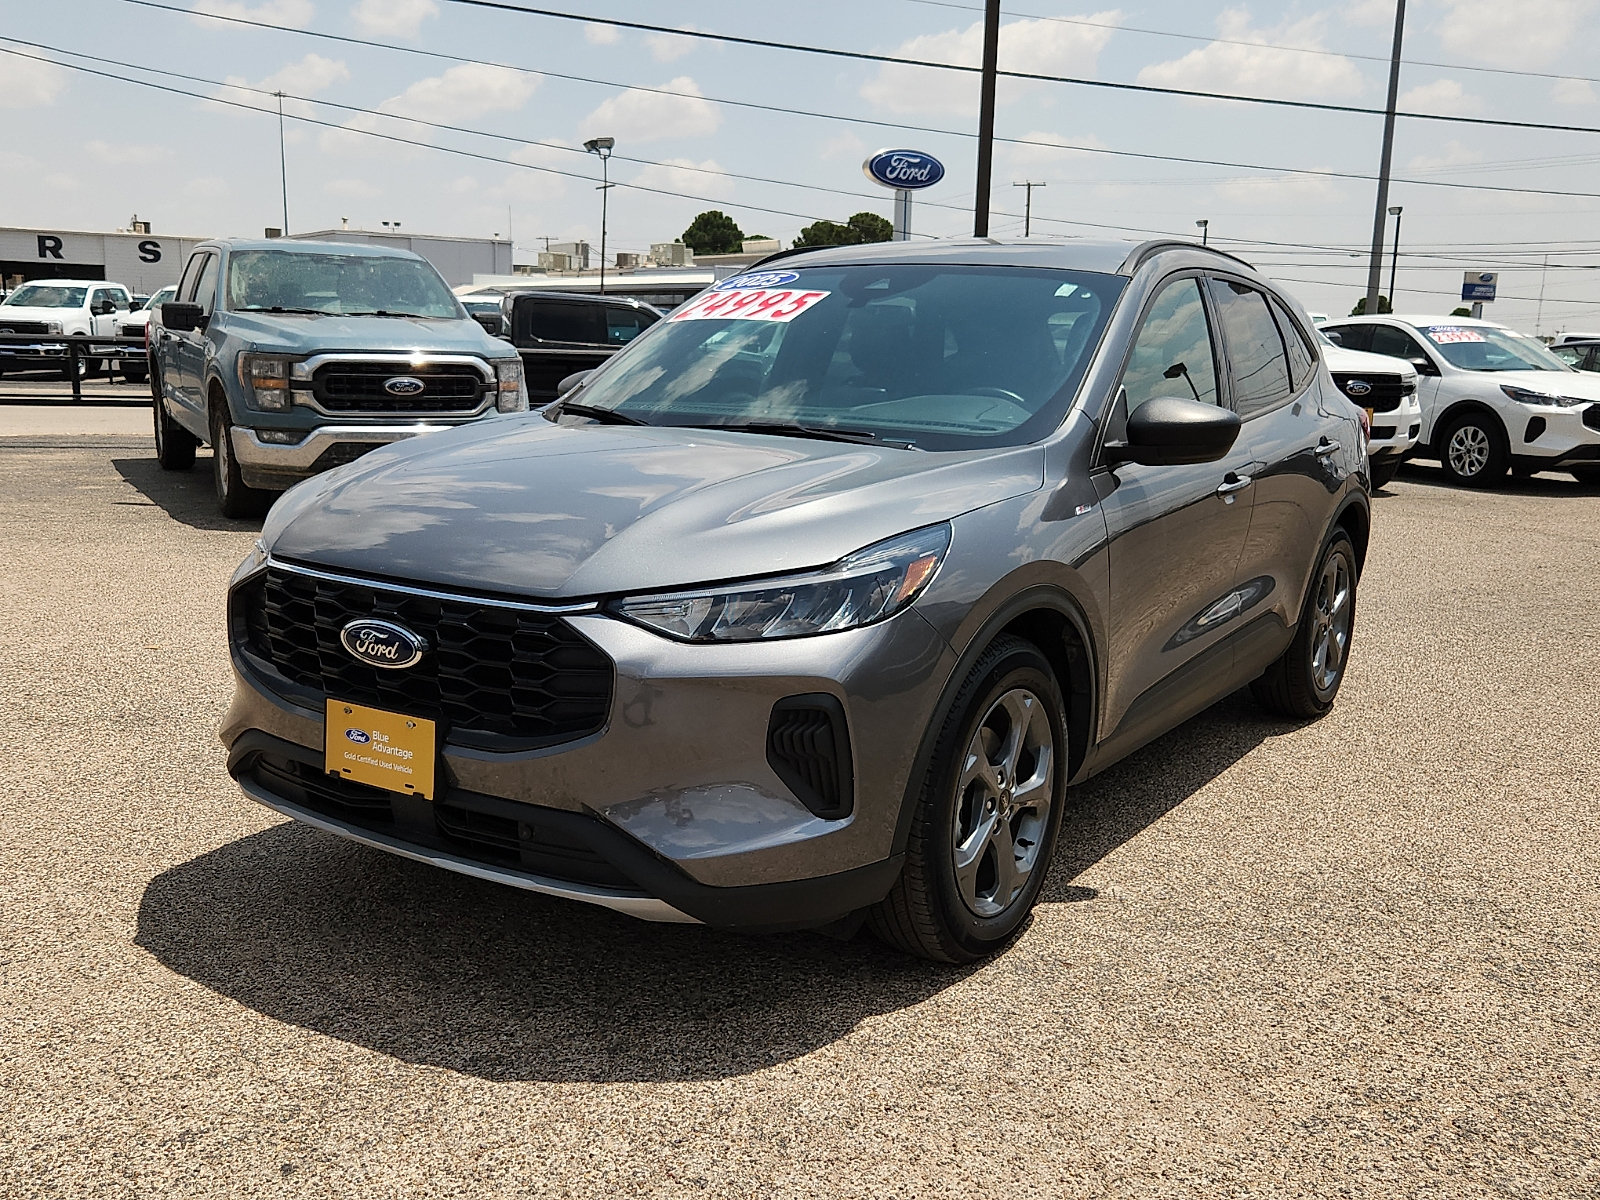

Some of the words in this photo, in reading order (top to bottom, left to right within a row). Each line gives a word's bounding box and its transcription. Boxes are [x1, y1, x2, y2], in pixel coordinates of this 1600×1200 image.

[886, 155, 932, 182] Ford
[37, 234, 65, 260] R
[138, 240, 162, 264] S
[672, 290, 825, 319] 24995
[355, 628, 400, 660] Ford
[349, 729, 367, 743] Ford
[372, 730, 390, 743] Blue
[344, 751, 357, 761] Gold
[356, 754, 379, 766] Certified
[378, 759, 393, 770] Used
[392, 763, 413, 775] Vehicle
[372, 741, 413, 760] Advantage
